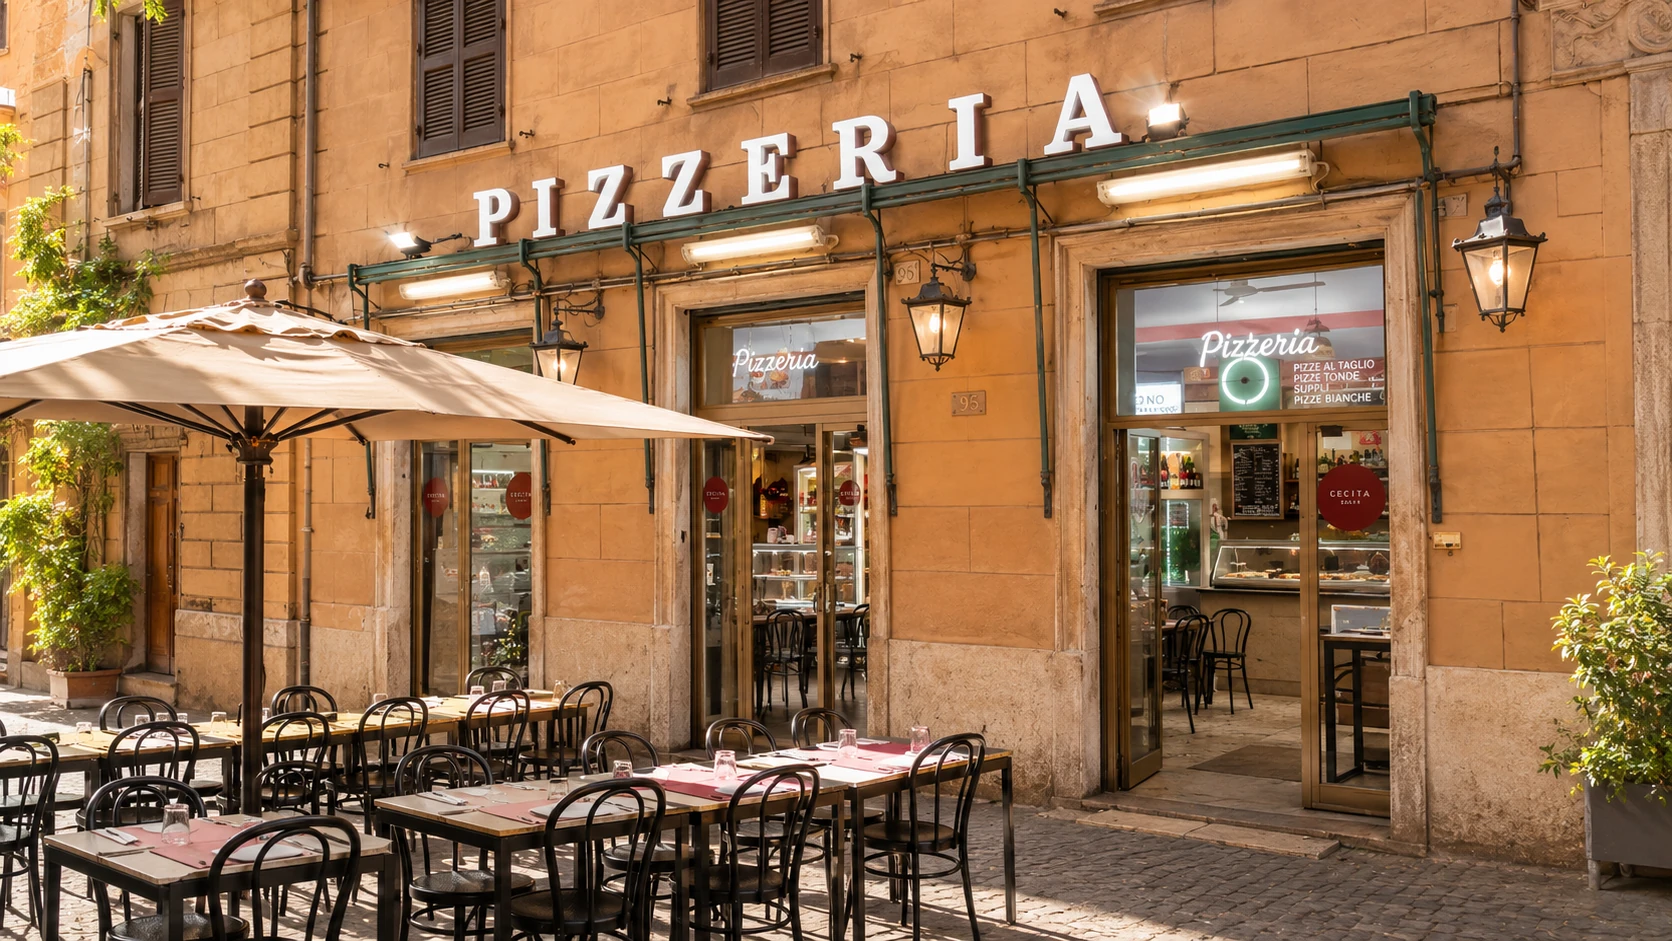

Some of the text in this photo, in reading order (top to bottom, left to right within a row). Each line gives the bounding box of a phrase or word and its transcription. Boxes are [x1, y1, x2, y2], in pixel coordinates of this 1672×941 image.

[473, 72, 1127, 247] PIZZERIA
[1199, 328, 1319, 367] Pizzeria
[732, 347, 819, 383] Pizzeria
[1293, 359, 1374, 372] PIZZE AL TAGLIO
[1293, 371, 1359, 383] PIZZE TONDE
[1294, 392, 1371, 405] PIZZE BIANCHE
[1329, 490, 1370, 498] CECITA
